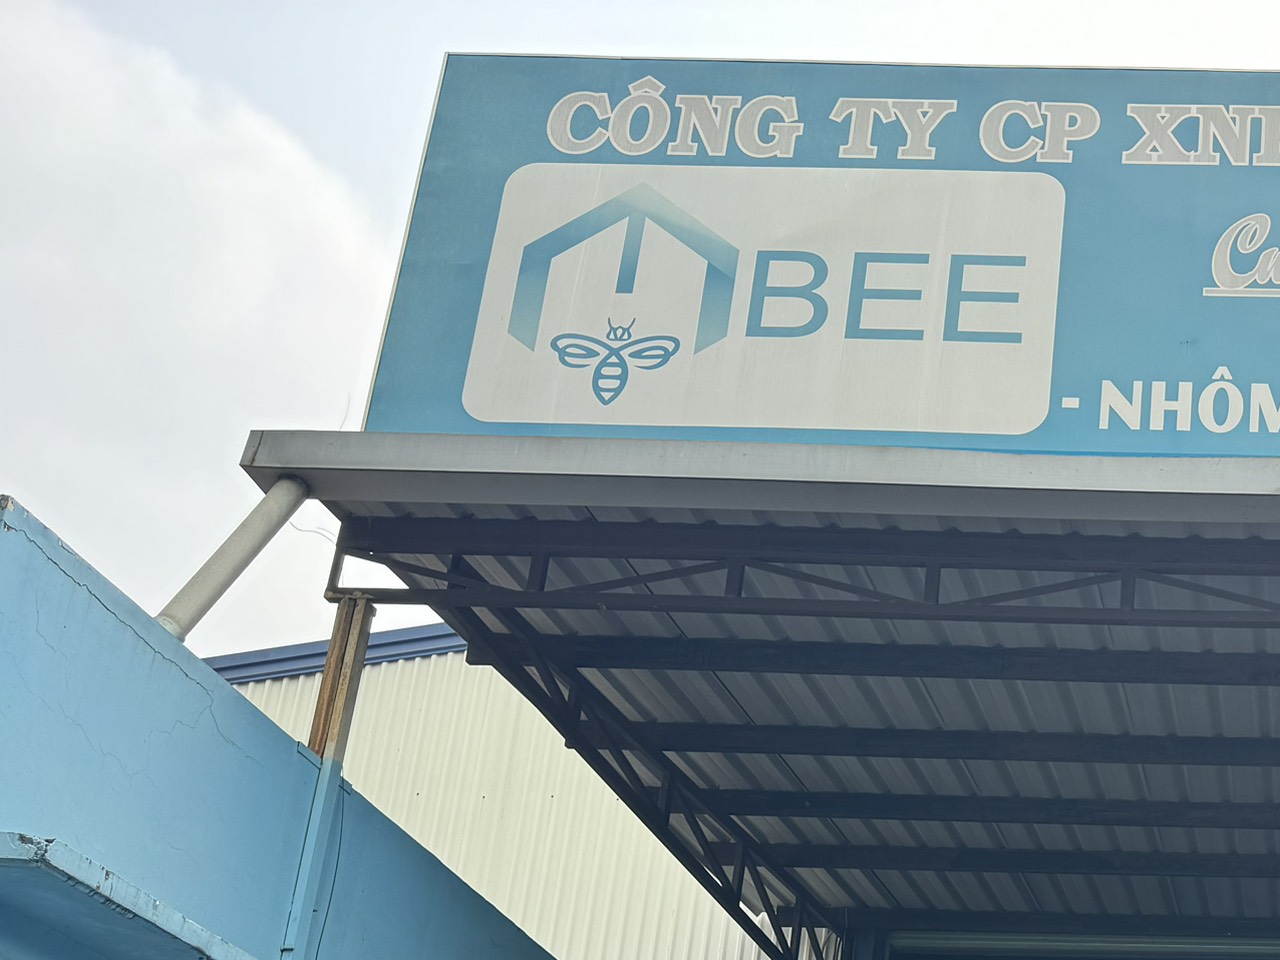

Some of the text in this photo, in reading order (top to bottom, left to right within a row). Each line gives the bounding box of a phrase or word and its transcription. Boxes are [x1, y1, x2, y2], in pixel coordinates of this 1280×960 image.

[546, 75, 804, 158] CÔNG
[830, 96, 957, 160] TY
[979, 100, 1101, 163] CP
